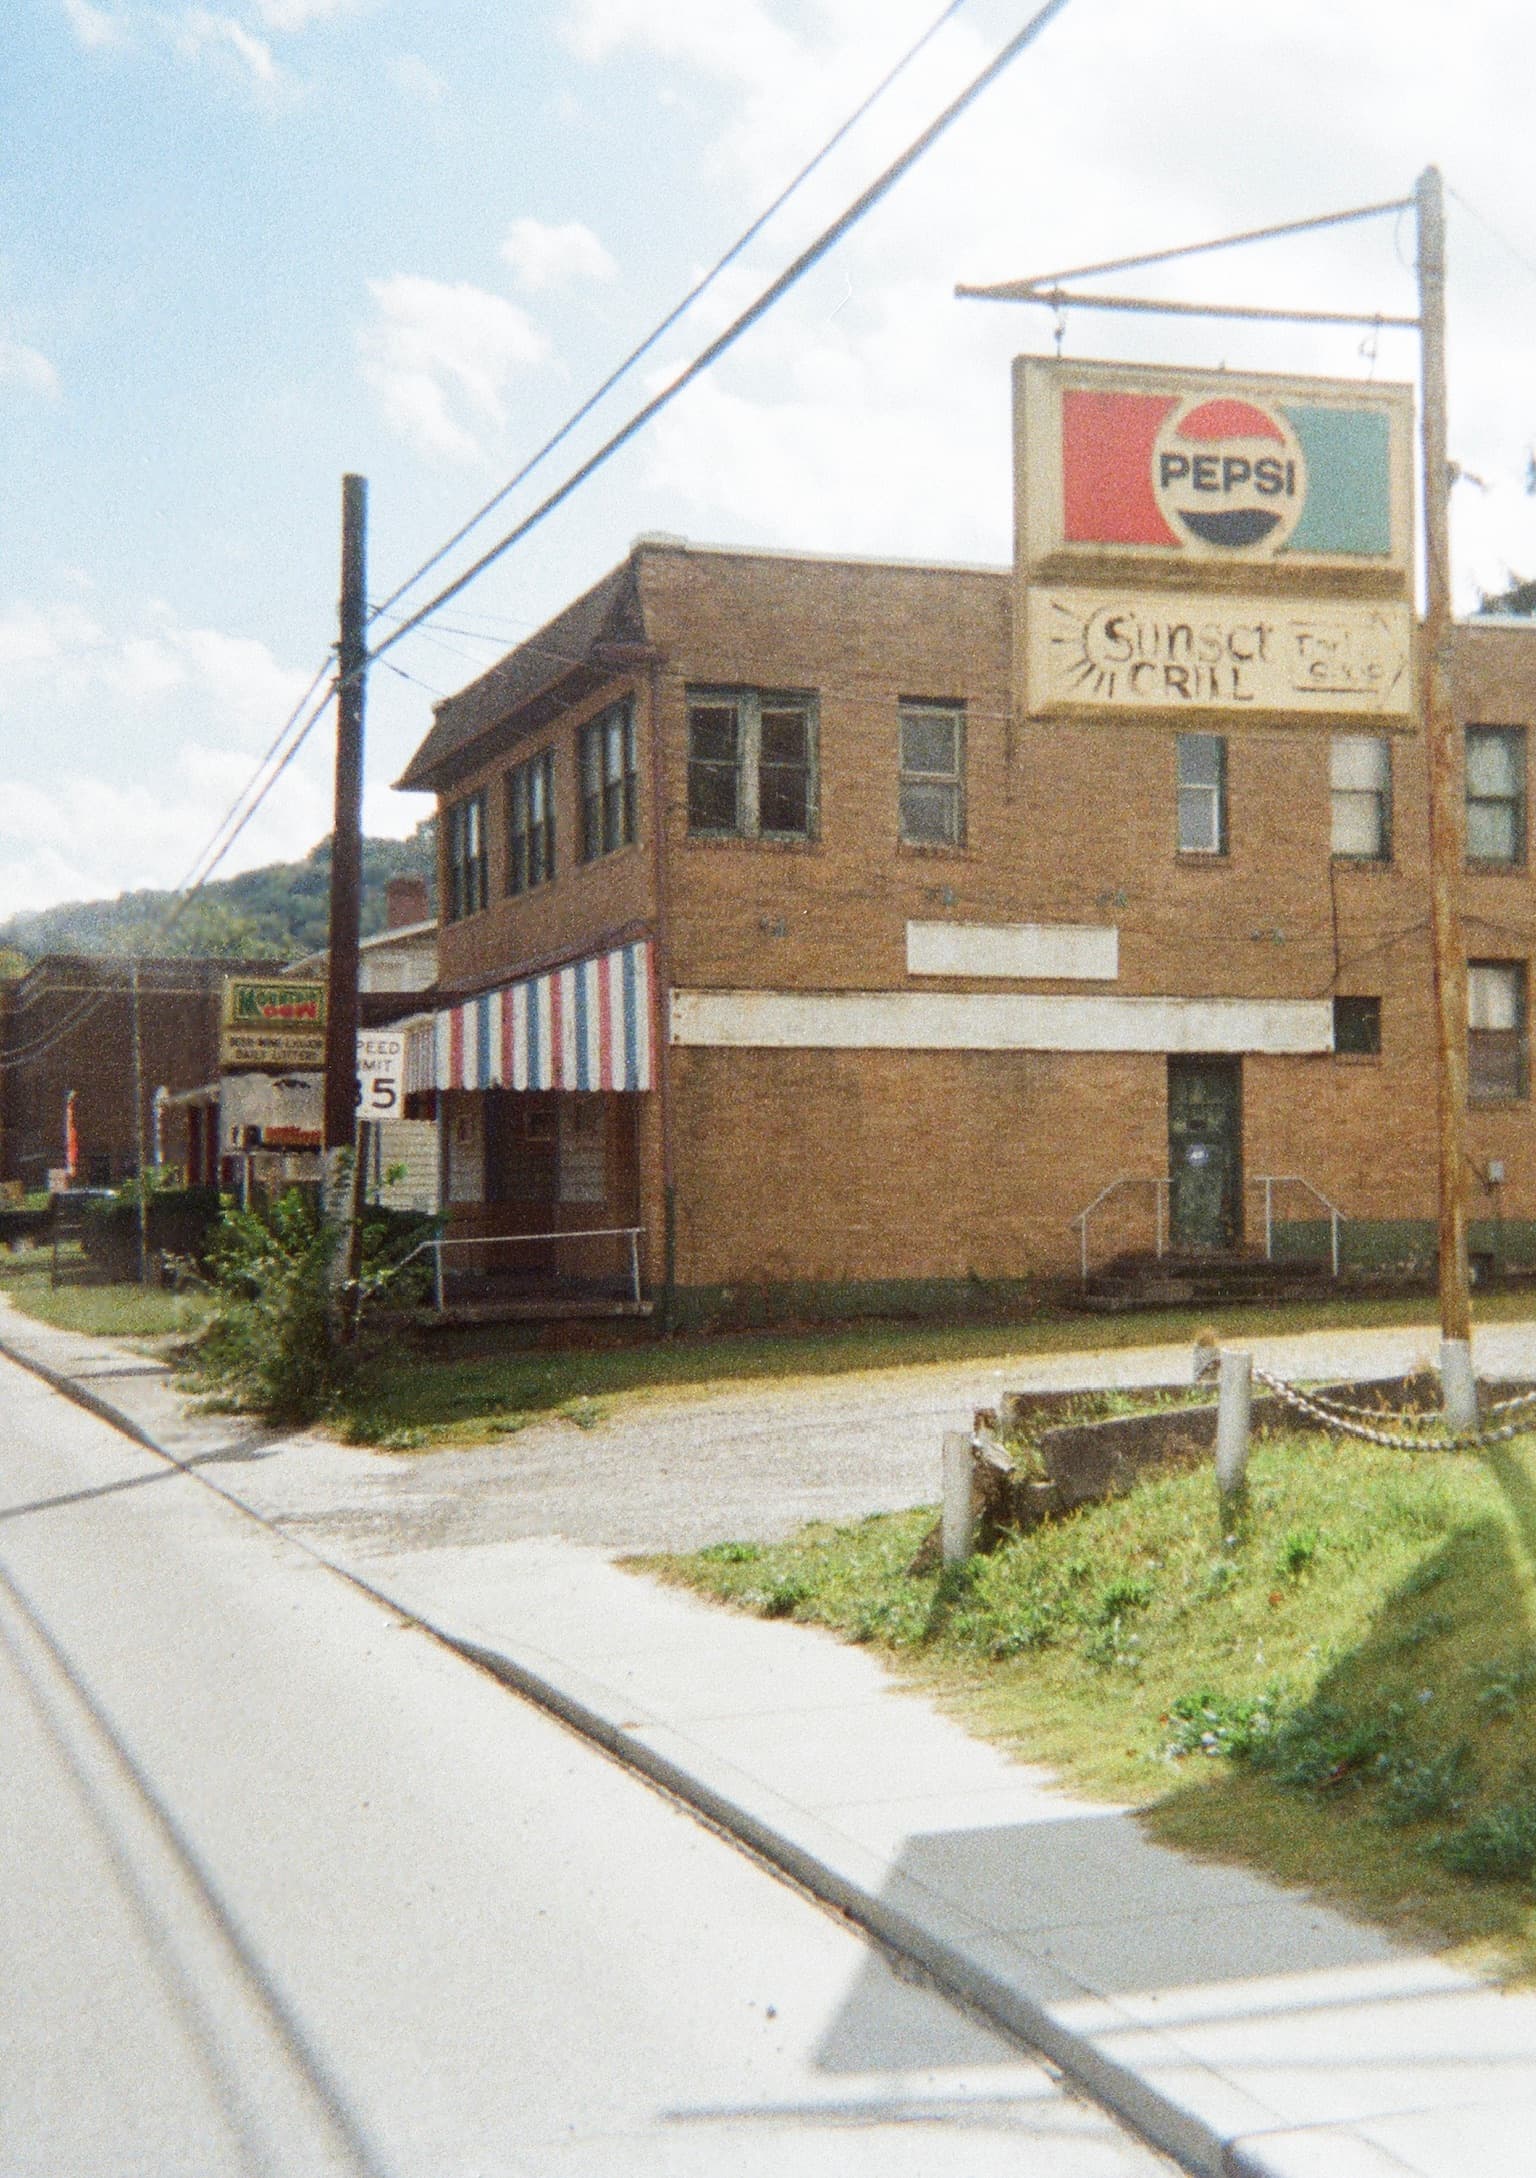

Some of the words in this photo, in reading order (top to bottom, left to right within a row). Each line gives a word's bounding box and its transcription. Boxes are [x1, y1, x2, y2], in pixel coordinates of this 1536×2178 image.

[1160, 452, 1297, 496] PEPSI
[357, 1040, 399, 1055] PEED
[356, 1078, 397, 1109] 5
